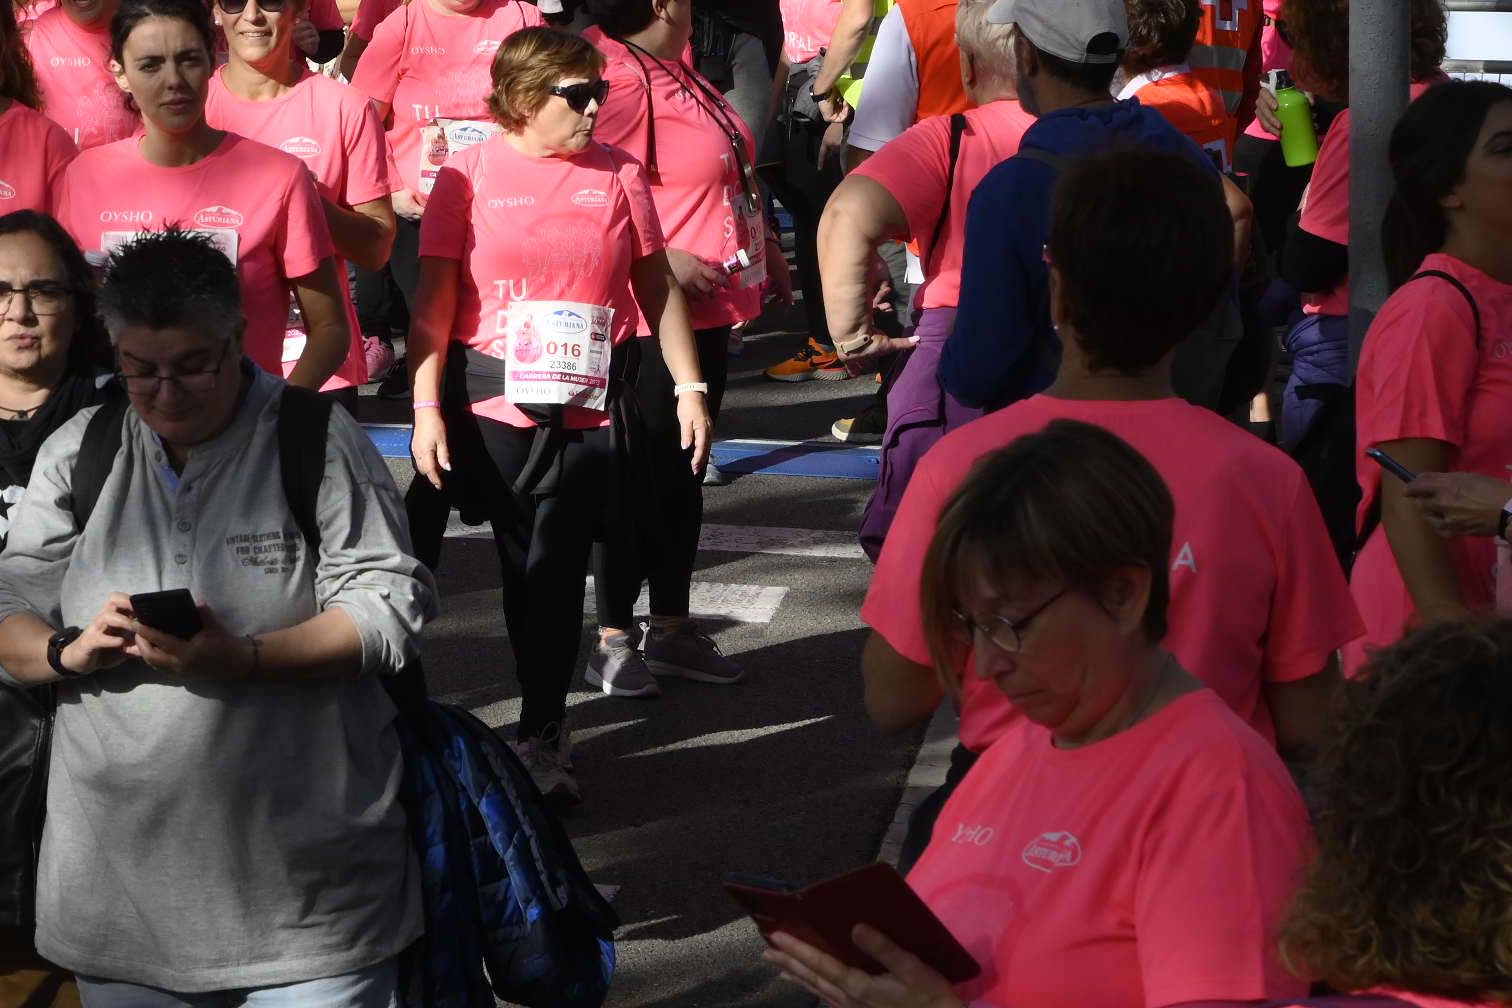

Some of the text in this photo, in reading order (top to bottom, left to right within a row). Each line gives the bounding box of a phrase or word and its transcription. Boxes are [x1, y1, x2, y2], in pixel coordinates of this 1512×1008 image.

[411, 47, 445, 56] OYSHO
[50, 56, 90, 67] OYSHO
[488, 195, 534, 208] OYSHO
[100, 210, 153, 222] OYSHO
[493, 278, 527, 301] TU
[546, 342, 581, 358] 016
[550, 360, 577, 371] 23386
